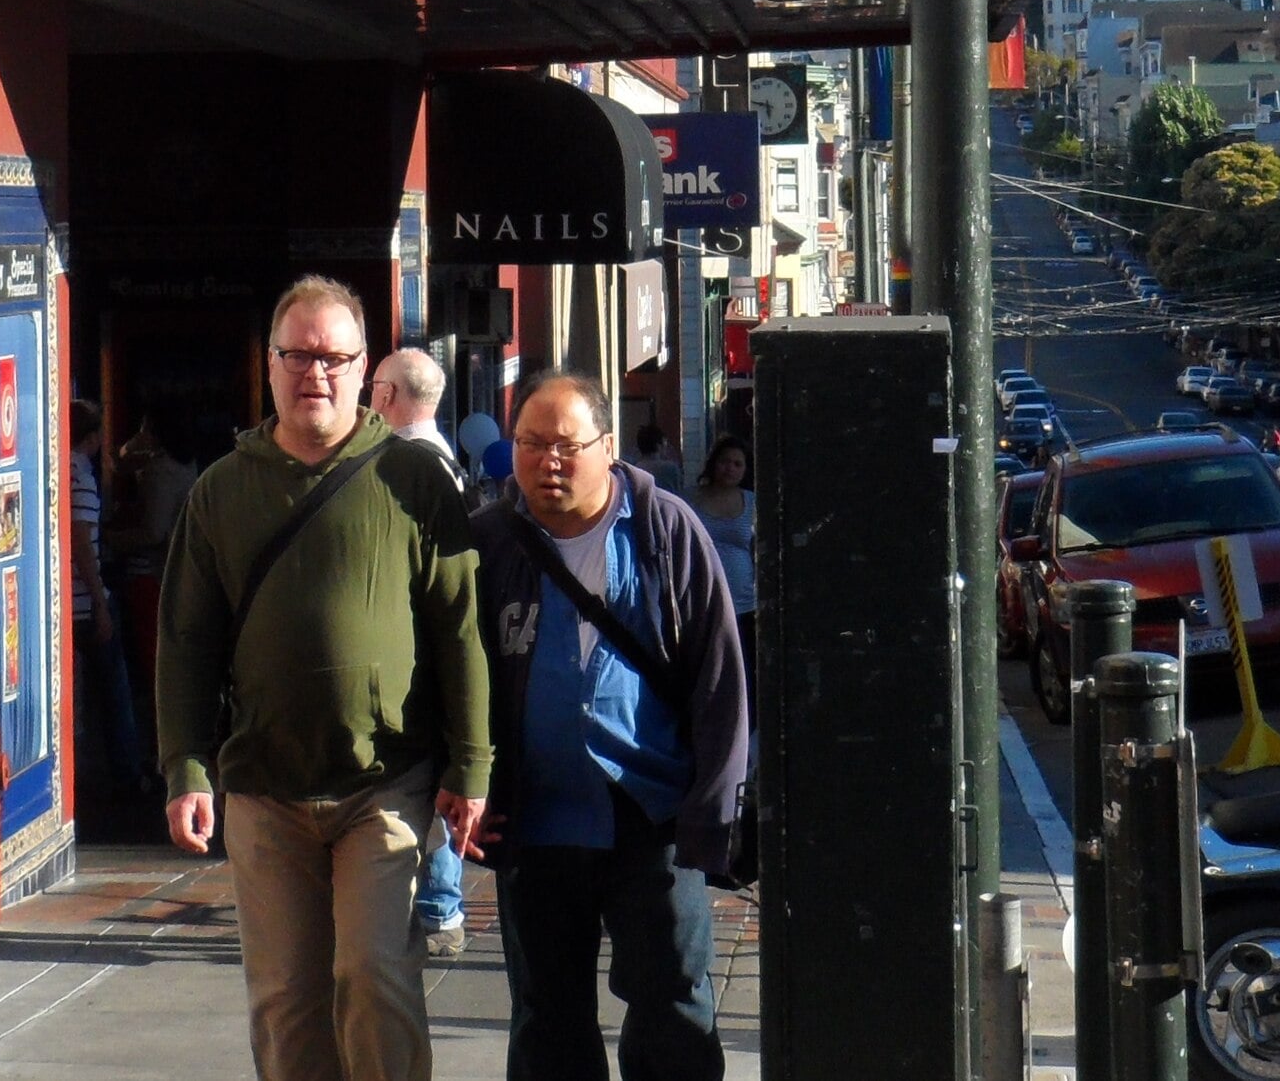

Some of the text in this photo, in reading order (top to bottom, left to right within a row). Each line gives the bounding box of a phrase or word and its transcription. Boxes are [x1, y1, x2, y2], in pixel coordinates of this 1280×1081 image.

[662, 165, 721, 195] ank
[453, 211, 610, 241] NAILS
[10, 249, 35, 283] Special
